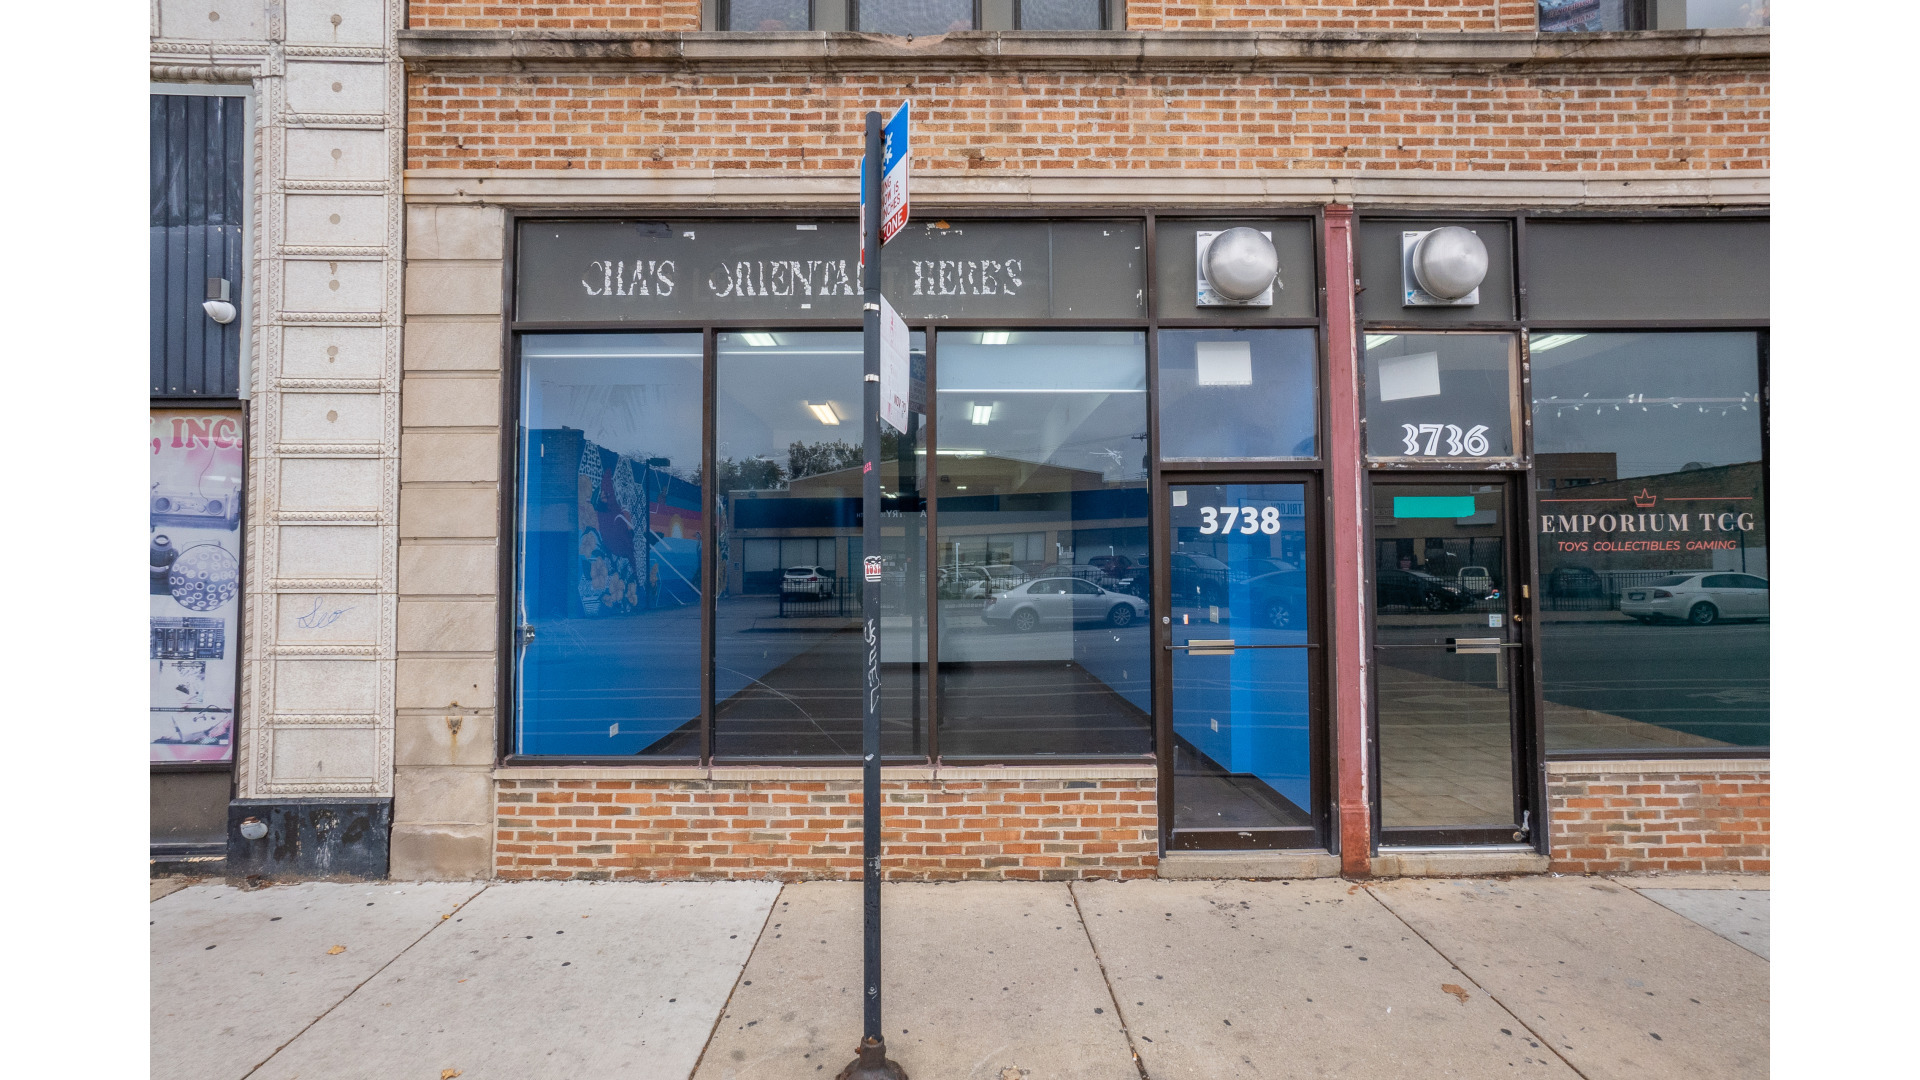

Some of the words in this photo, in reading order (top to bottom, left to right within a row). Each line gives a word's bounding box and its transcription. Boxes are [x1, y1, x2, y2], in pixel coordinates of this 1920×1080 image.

[1402, 424, 1489, 456] 3736
[1200, 507, 1280, 535] 3738
[1541, 513, 1690, 533] EMPORIUM
[1699, 512, 1755, 532] TCG
[1558, 541, 1588, 552] TOYS
[1593, 540, 1681, 551] COLLECTIBLES
[1686, 540, 1737, 550] GAMING
